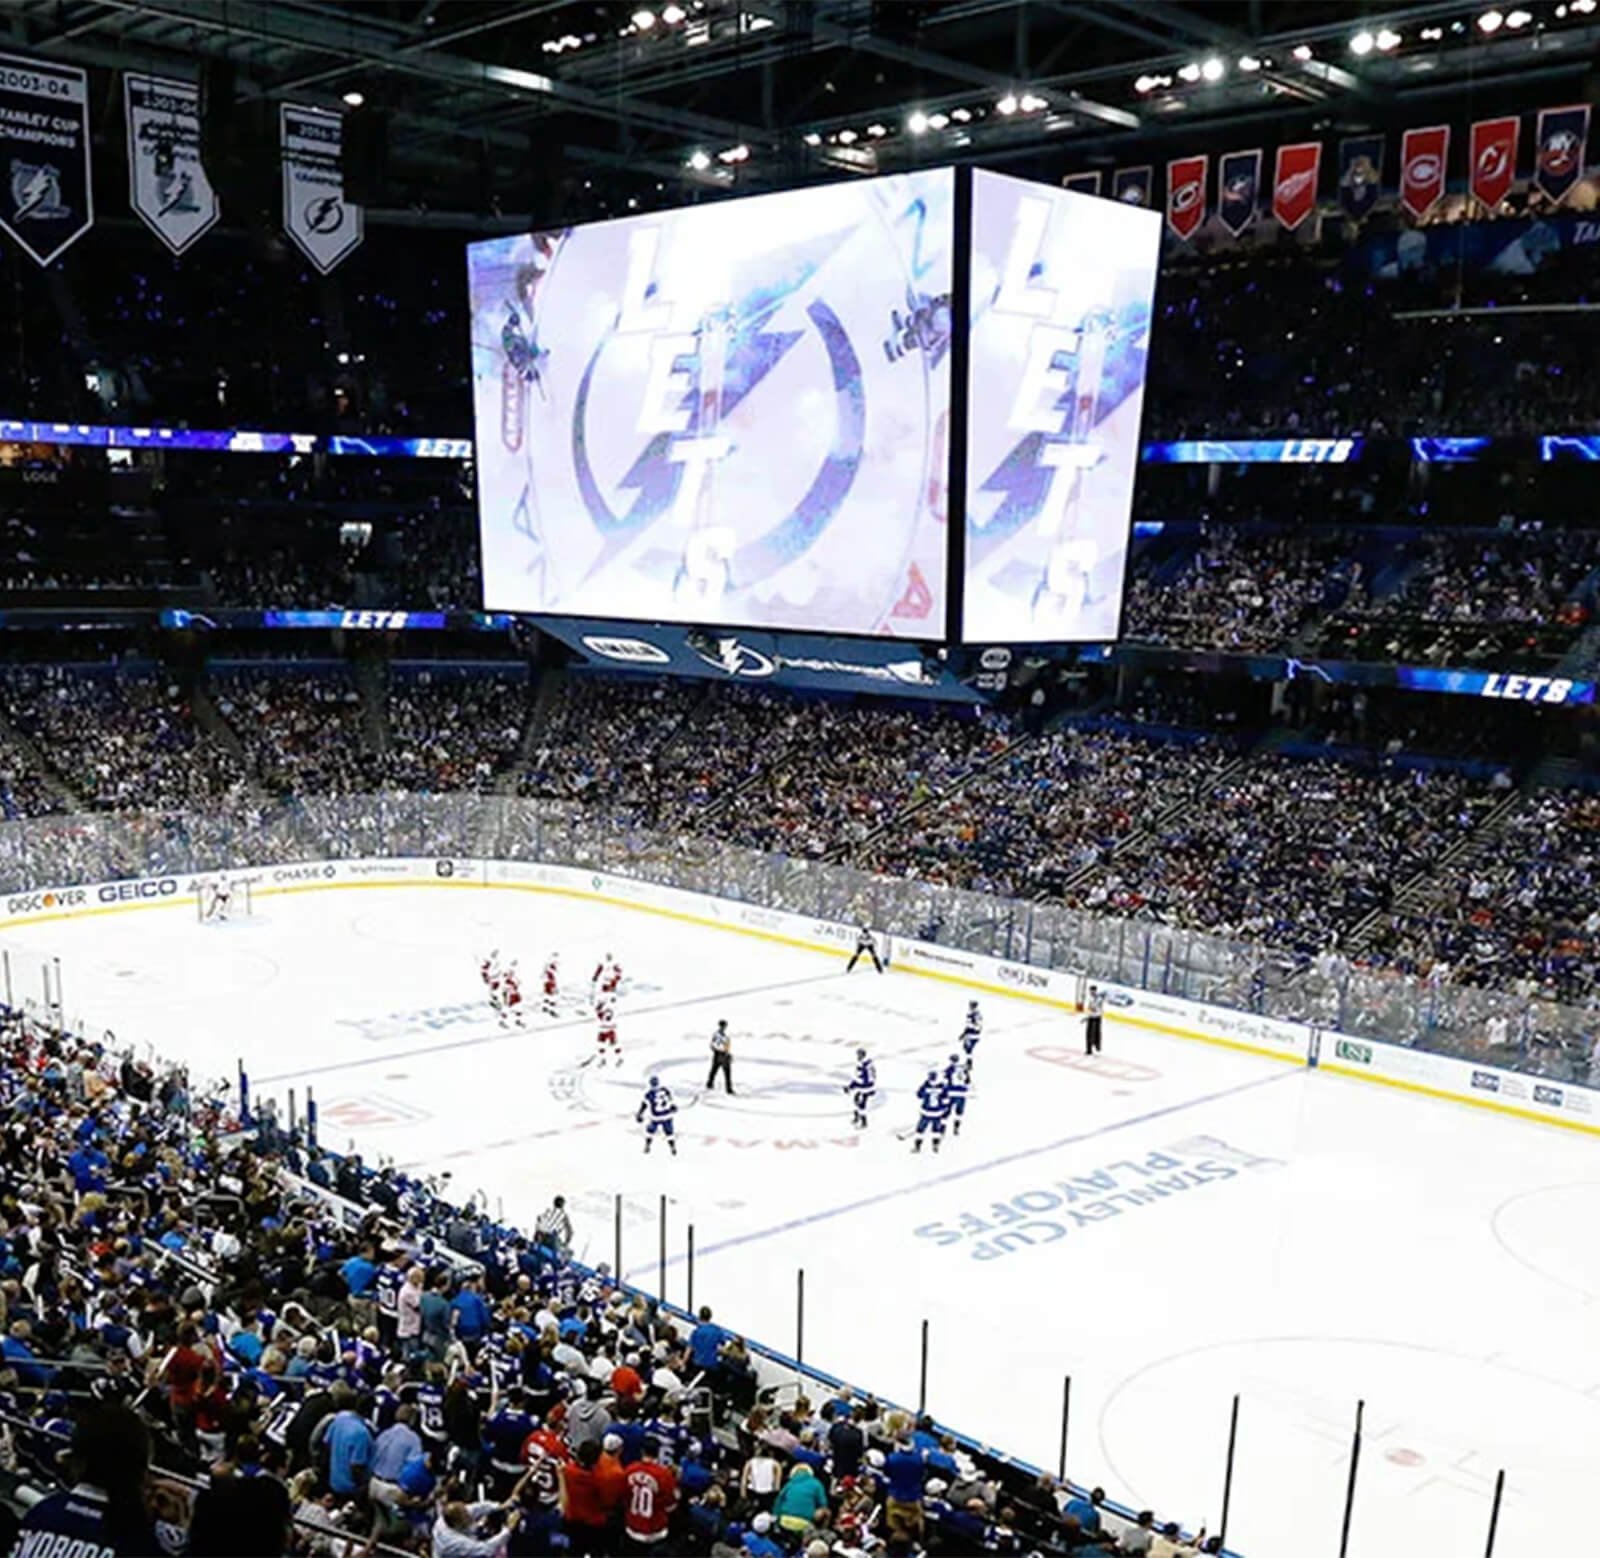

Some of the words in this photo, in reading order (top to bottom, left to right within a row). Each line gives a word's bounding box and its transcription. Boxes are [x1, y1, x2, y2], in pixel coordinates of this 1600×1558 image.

[98, 879, 178, 903] GEICO
[913, 1151, 1184, 1246] PLAYOFFS
[1067, 1160, 1239, 1227] STANLEY
[970, 1220, 1068, 1262] CUP
